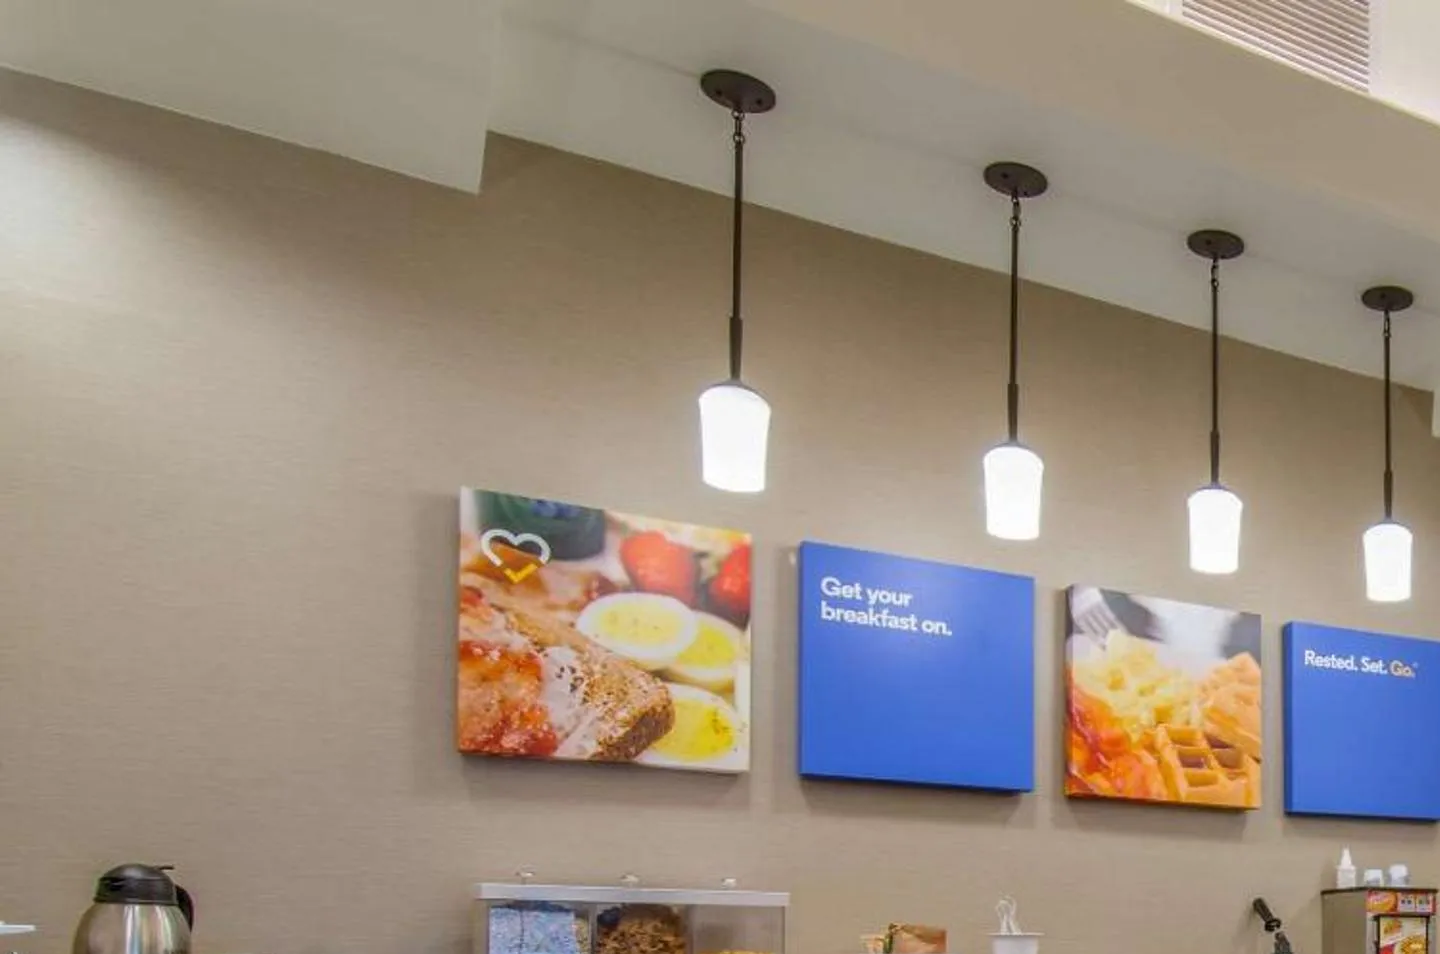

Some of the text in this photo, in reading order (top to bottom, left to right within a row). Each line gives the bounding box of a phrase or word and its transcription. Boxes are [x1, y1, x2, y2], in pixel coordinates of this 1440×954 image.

[820, 576, 913, 607] Get your
[820, 600, 953, 636] breakfast on.
[1304, 649, 1358, 671] Rested.
[1361, 656, 1388, 675] Set.
